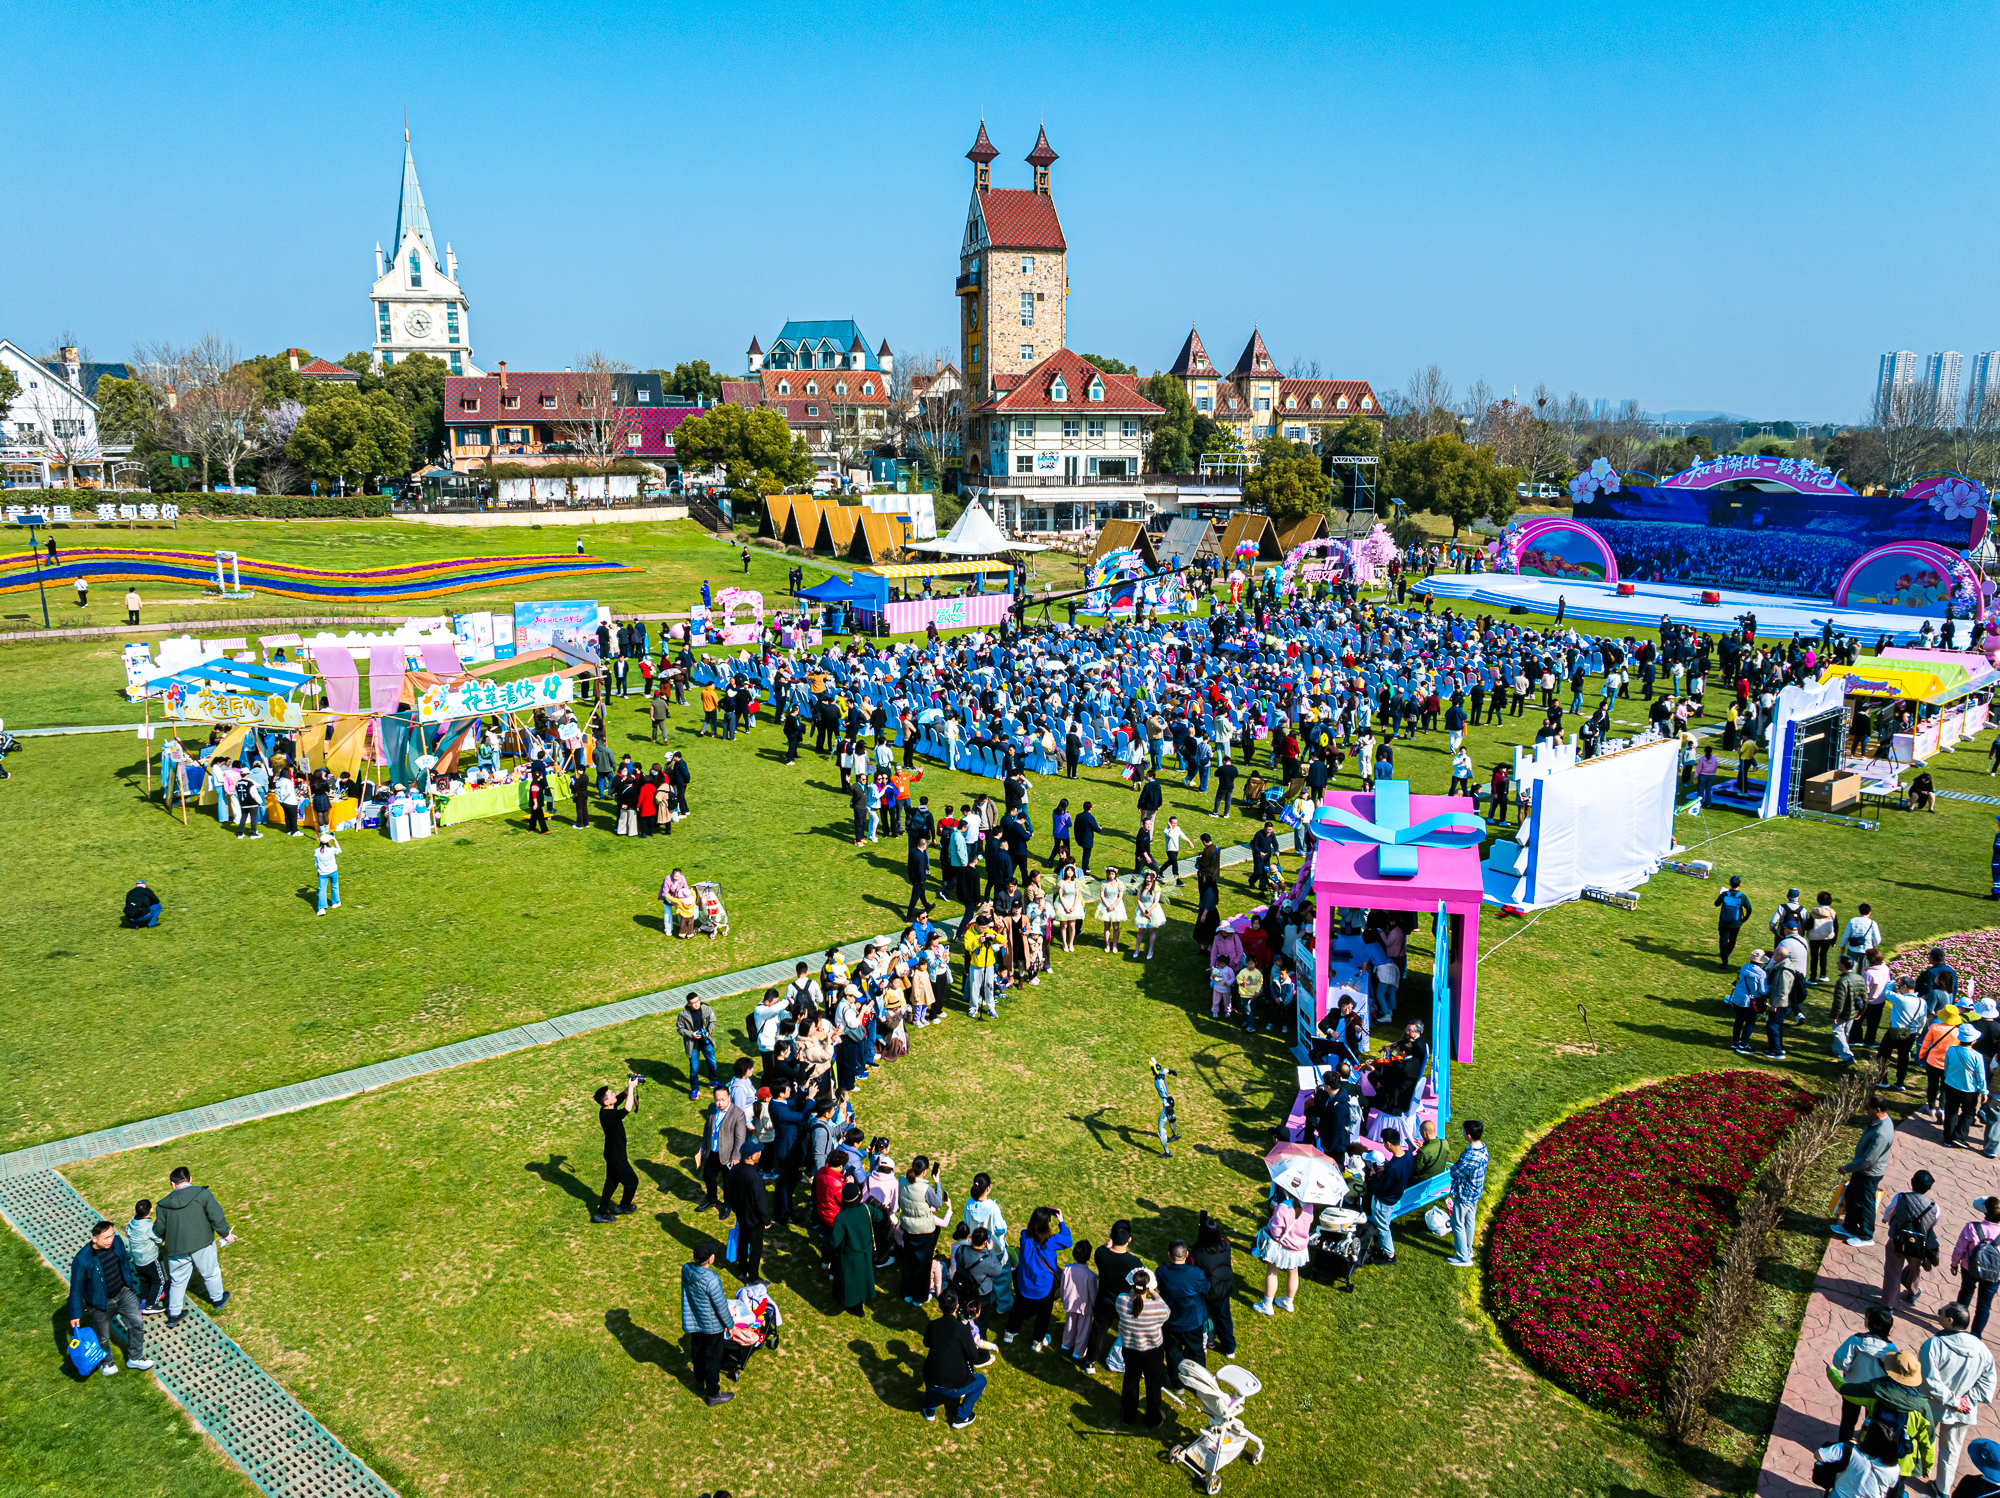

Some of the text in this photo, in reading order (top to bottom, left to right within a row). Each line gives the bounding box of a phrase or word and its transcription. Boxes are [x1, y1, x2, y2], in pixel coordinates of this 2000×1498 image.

[1678, 454, 1844, 490] 知音湖北一路繁花
[0, 503, 180, 522] 音故里 蔡甸等你
[1324, 556, 1341, 570] 17
[953, 602, 964, 613] 17
